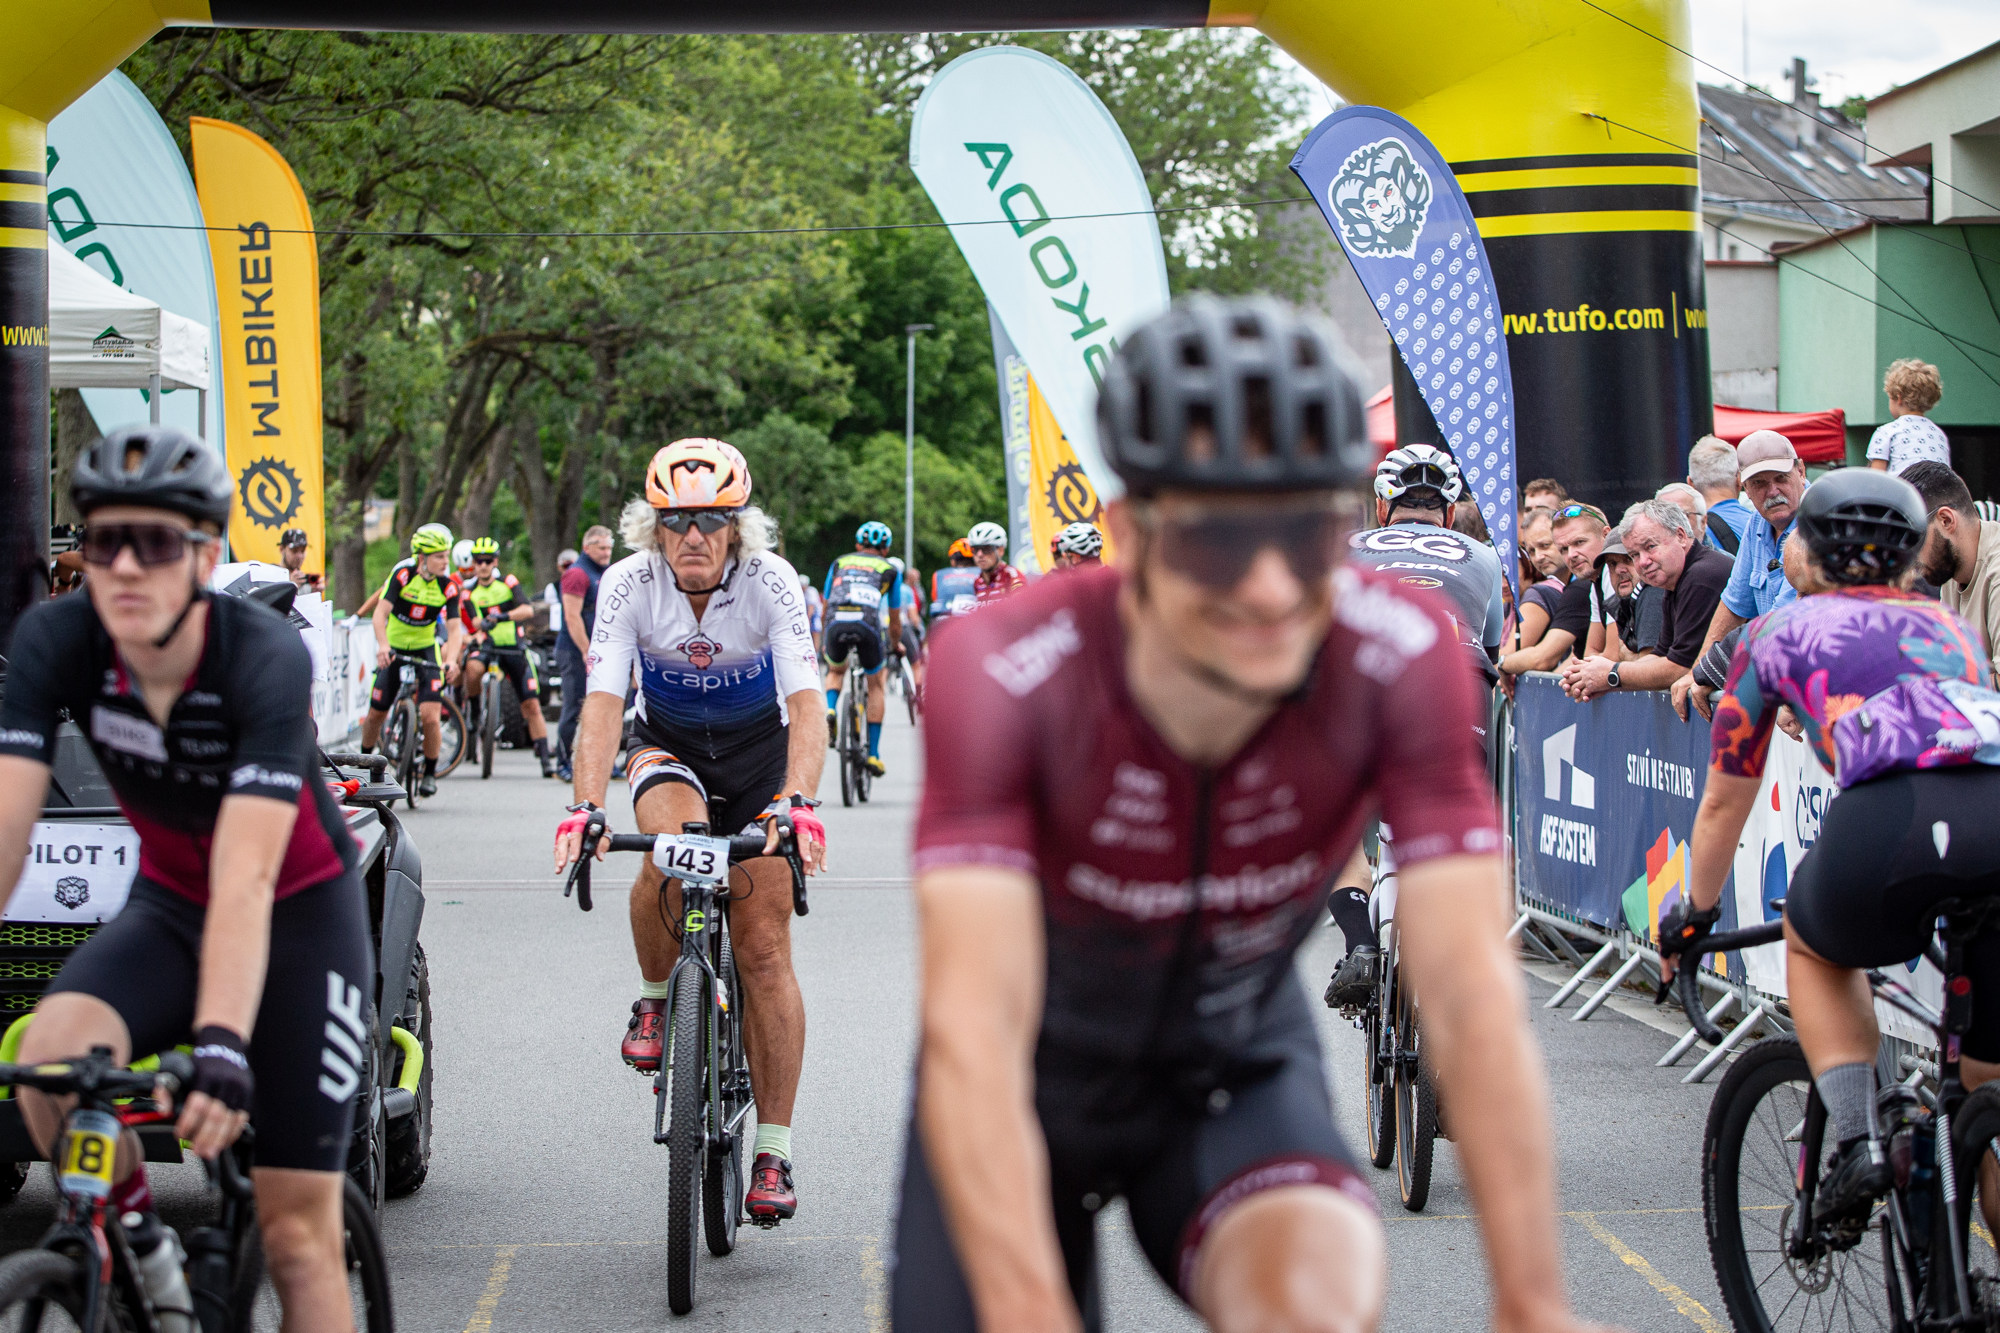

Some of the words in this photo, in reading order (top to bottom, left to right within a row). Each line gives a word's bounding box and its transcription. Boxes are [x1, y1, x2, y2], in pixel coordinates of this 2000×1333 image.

[761, 570, 810, 641] capital
[662, 655, 767, 692] capital
[1664, 761, 1696, 800] STAVB
[113, 845, 126, 866] 1
[665, 845, 715, 875] 143
[1557, 817, 1596, 867] SYSTEM
